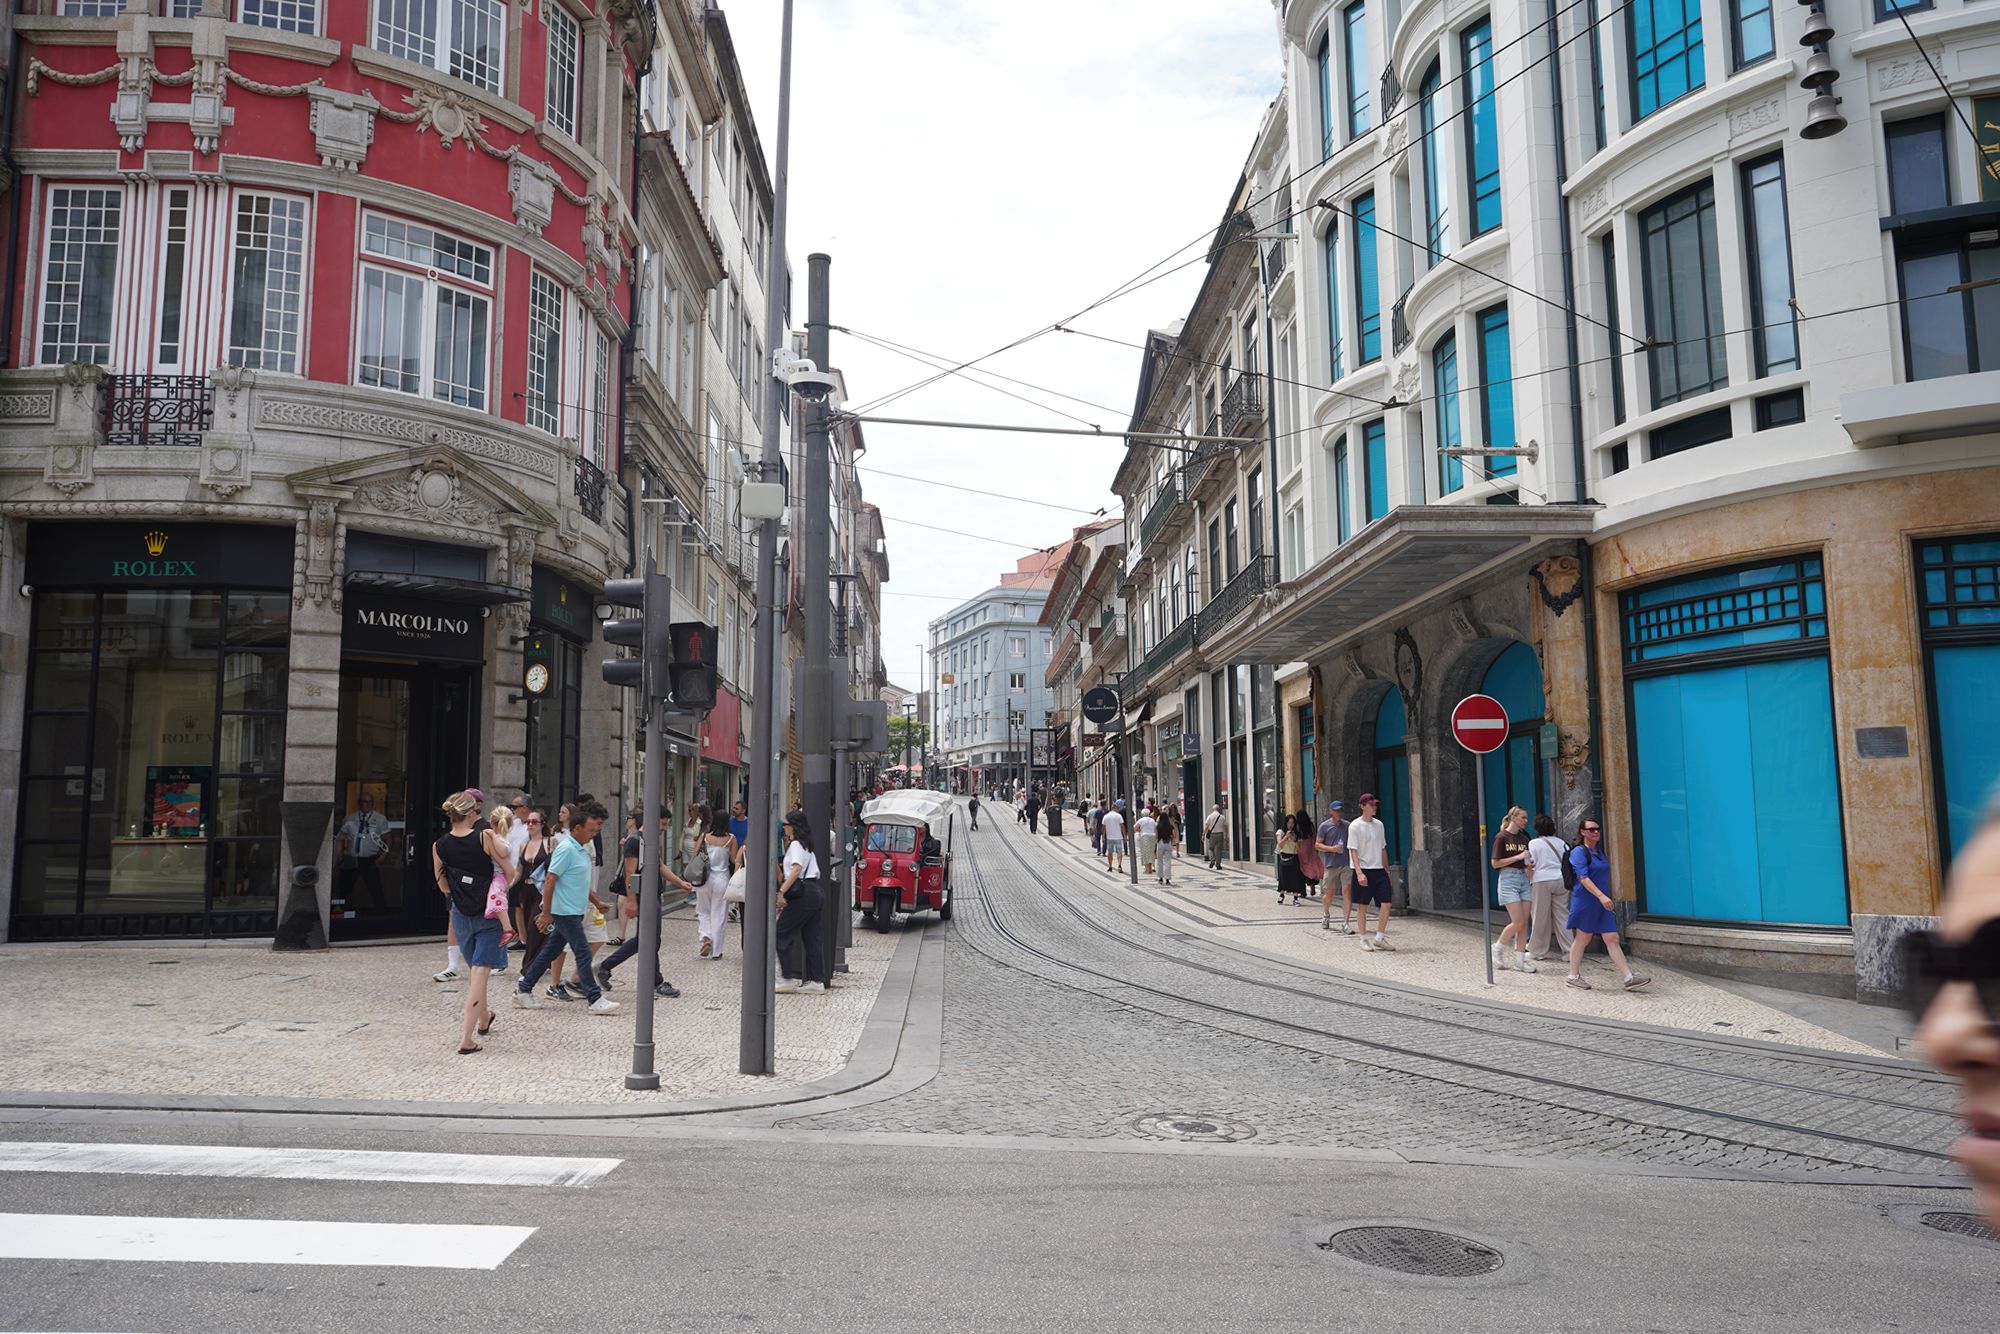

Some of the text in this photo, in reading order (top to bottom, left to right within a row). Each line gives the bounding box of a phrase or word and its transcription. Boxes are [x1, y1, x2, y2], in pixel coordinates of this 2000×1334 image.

[112, 560, 197, 577] ROLEX
[357, 608, 469, 635] MARCOLINO
[396, 630, 415, 638] SINCE
